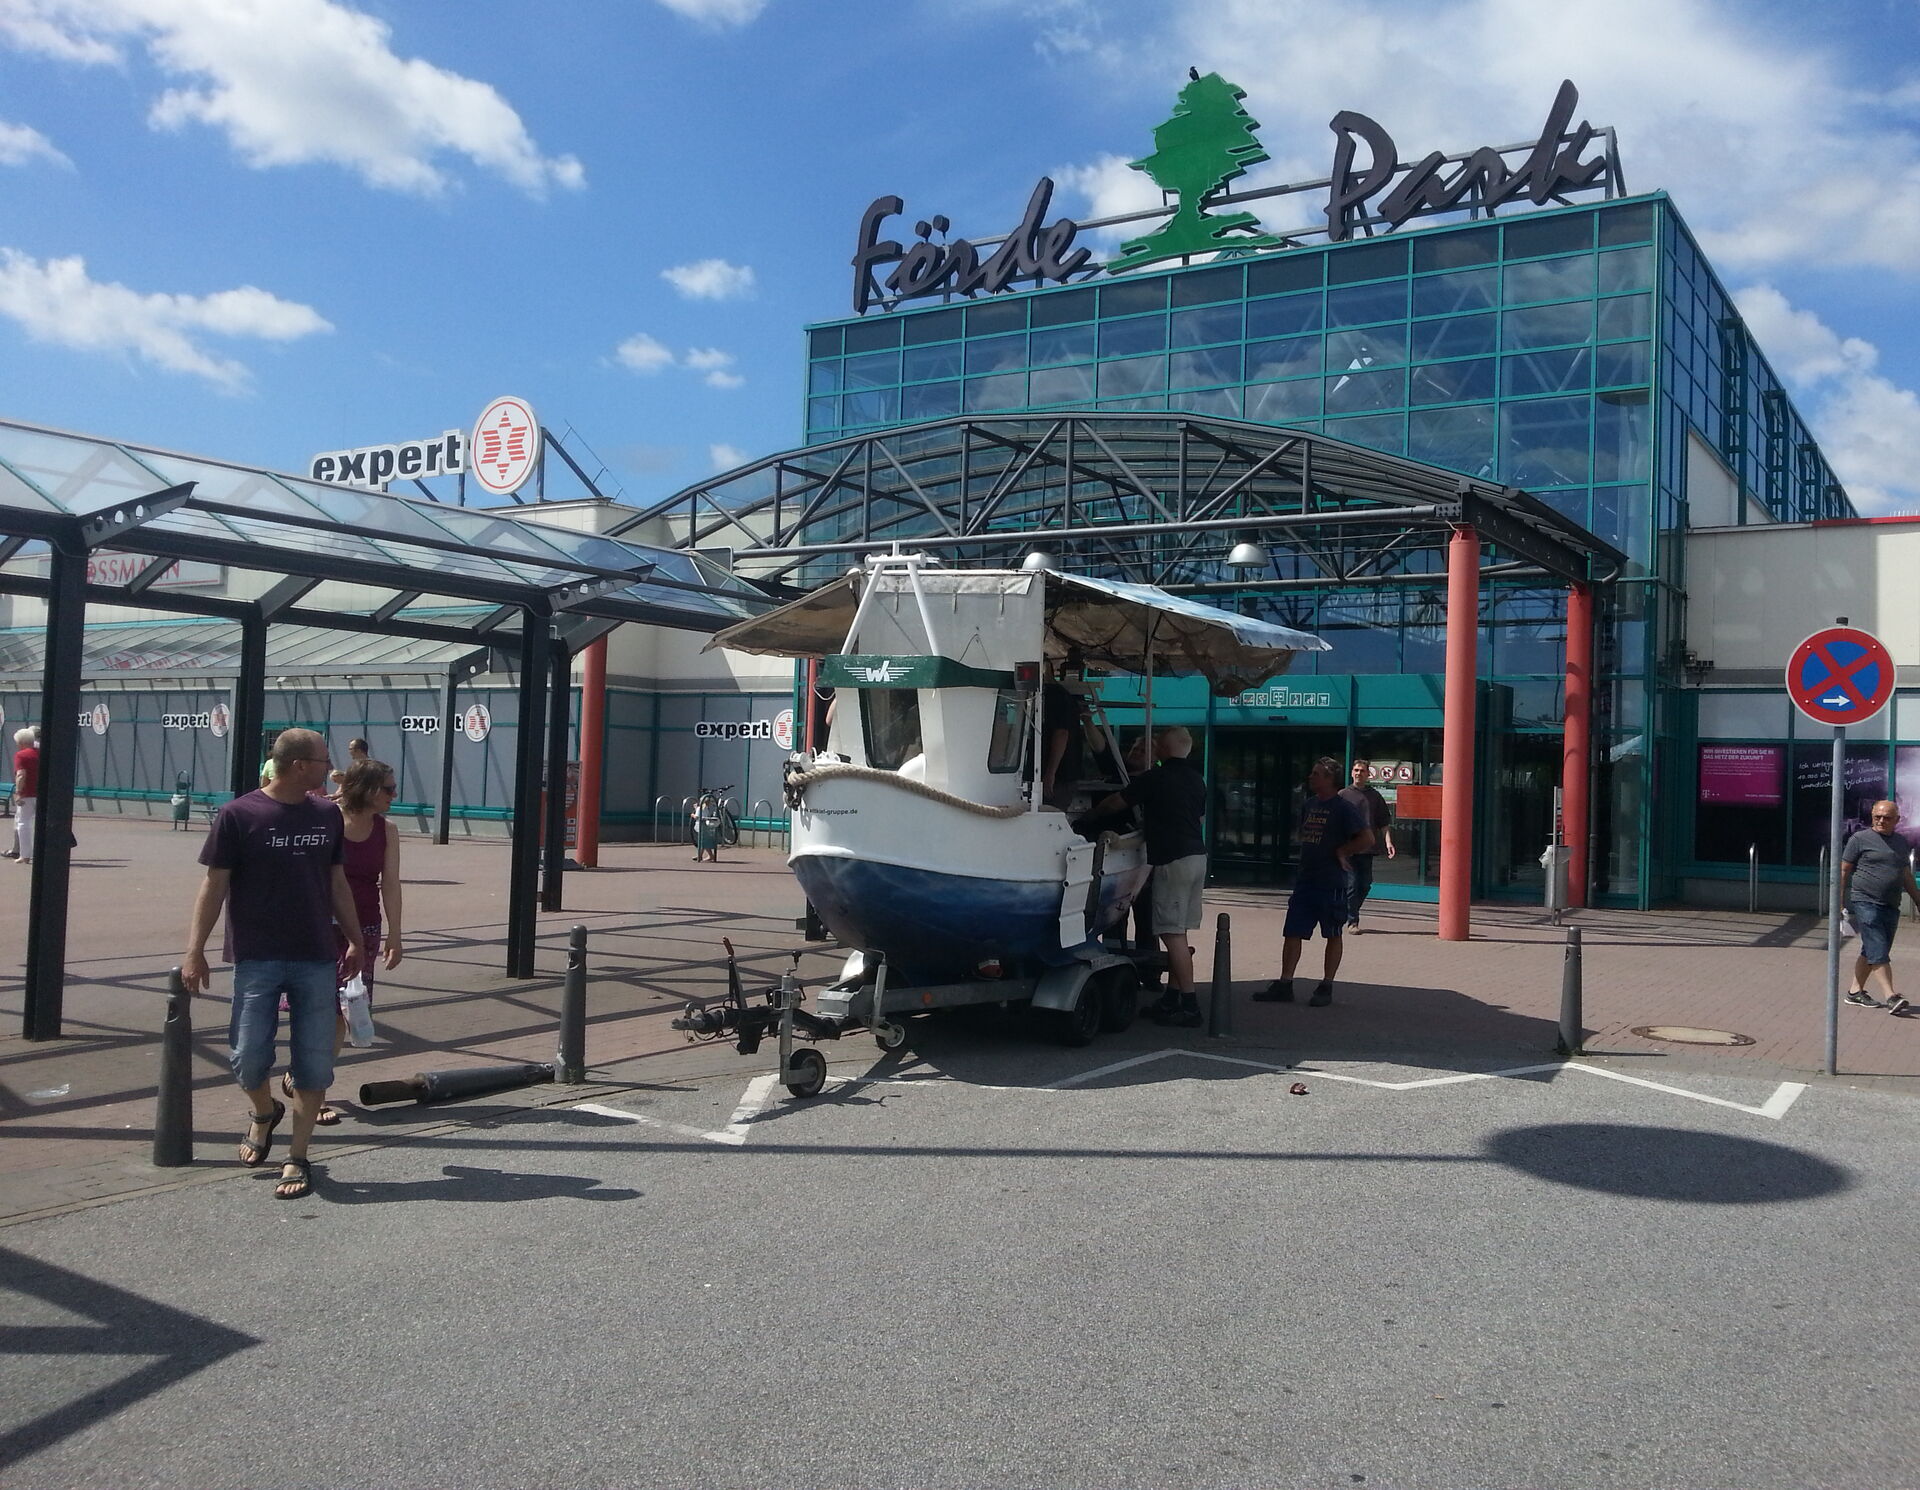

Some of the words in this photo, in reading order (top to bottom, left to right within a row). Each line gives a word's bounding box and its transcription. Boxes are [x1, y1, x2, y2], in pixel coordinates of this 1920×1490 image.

[1323, 79, 1607, 242] Park
[312, 434, 461, 486] expert
[162, 713, 208, 729] expert
[401, 715, 462, 732] expt
[695, 721, 769, 739] expert
